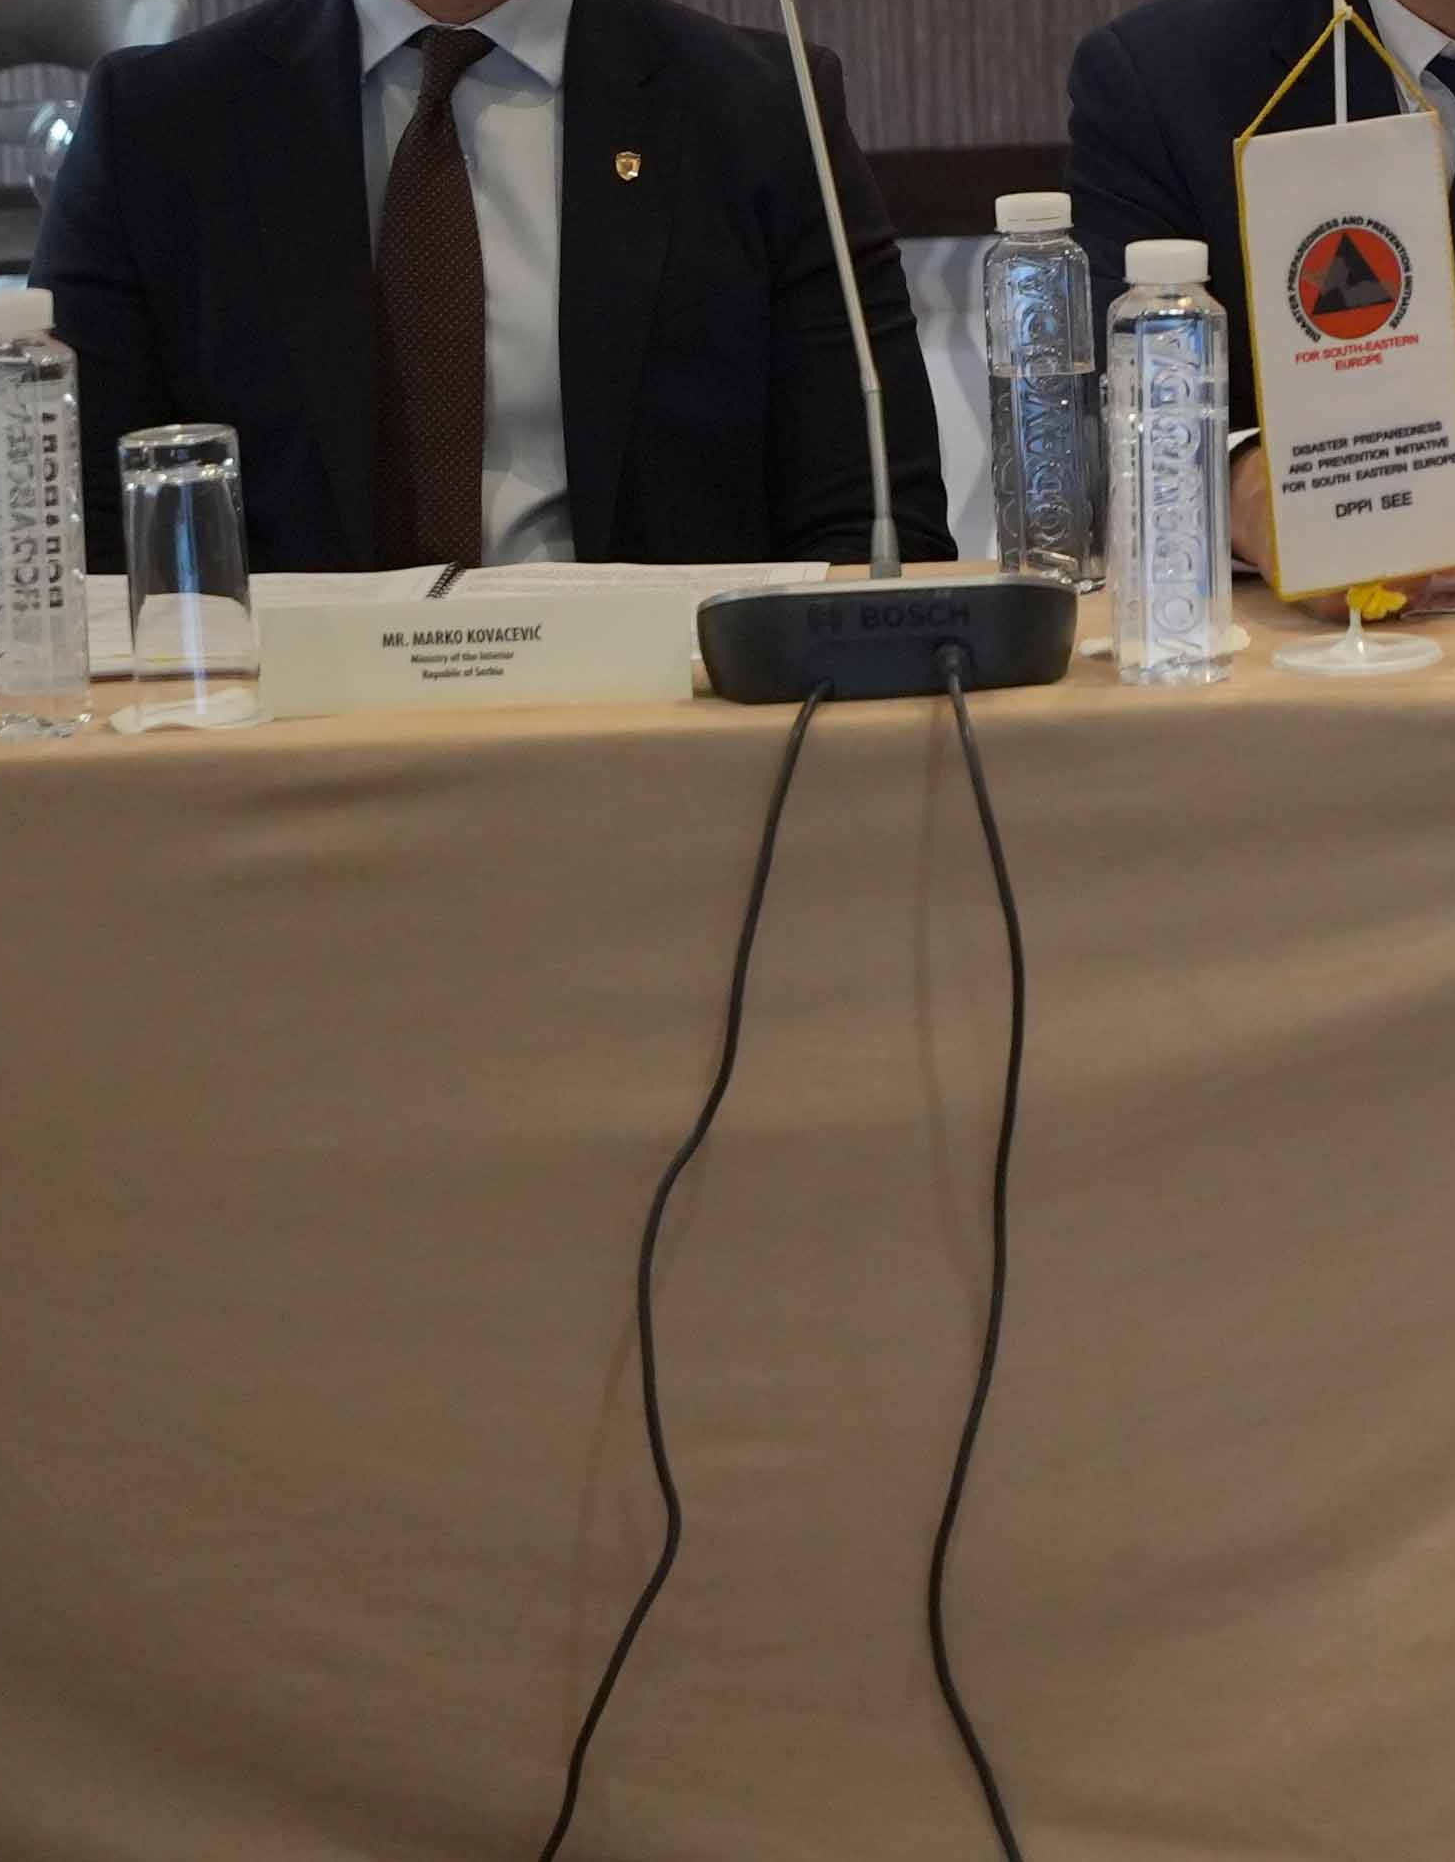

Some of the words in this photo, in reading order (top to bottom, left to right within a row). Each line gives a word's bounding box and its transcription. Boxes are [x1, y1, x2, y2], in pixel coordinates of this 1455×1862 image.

[1341, 216, 1364, 227] AND
[1295, 350, 1321, 364] FOR
[1334, 352, 1384, 372] EUROPE
[1292, 438, 1349, 457] DISASTER
[1352, 421, 1443, 445] PREPAREDNESS
[1289, 462, 1314, 475] AND
[1317, 447, 1390, 470] PREVENTION
[1393, 436, 1450, 456] INITIATIVE
[1282, 480, 1307, 494] FOR
[1311, 473, 1352, 489] SOUTH
[1356, 462, 1408, 482] EASTERN
[1335, 497, 1374, 519] DPPI
[1380, 491, 1413, 510] SEE
[859, 601, 971, 630] BOSCH
[382, 632, 409, 649] MR.
[412, 629, 464, 647] MARKO
[466, 623, 542, 644] KOVACEVIĆ
